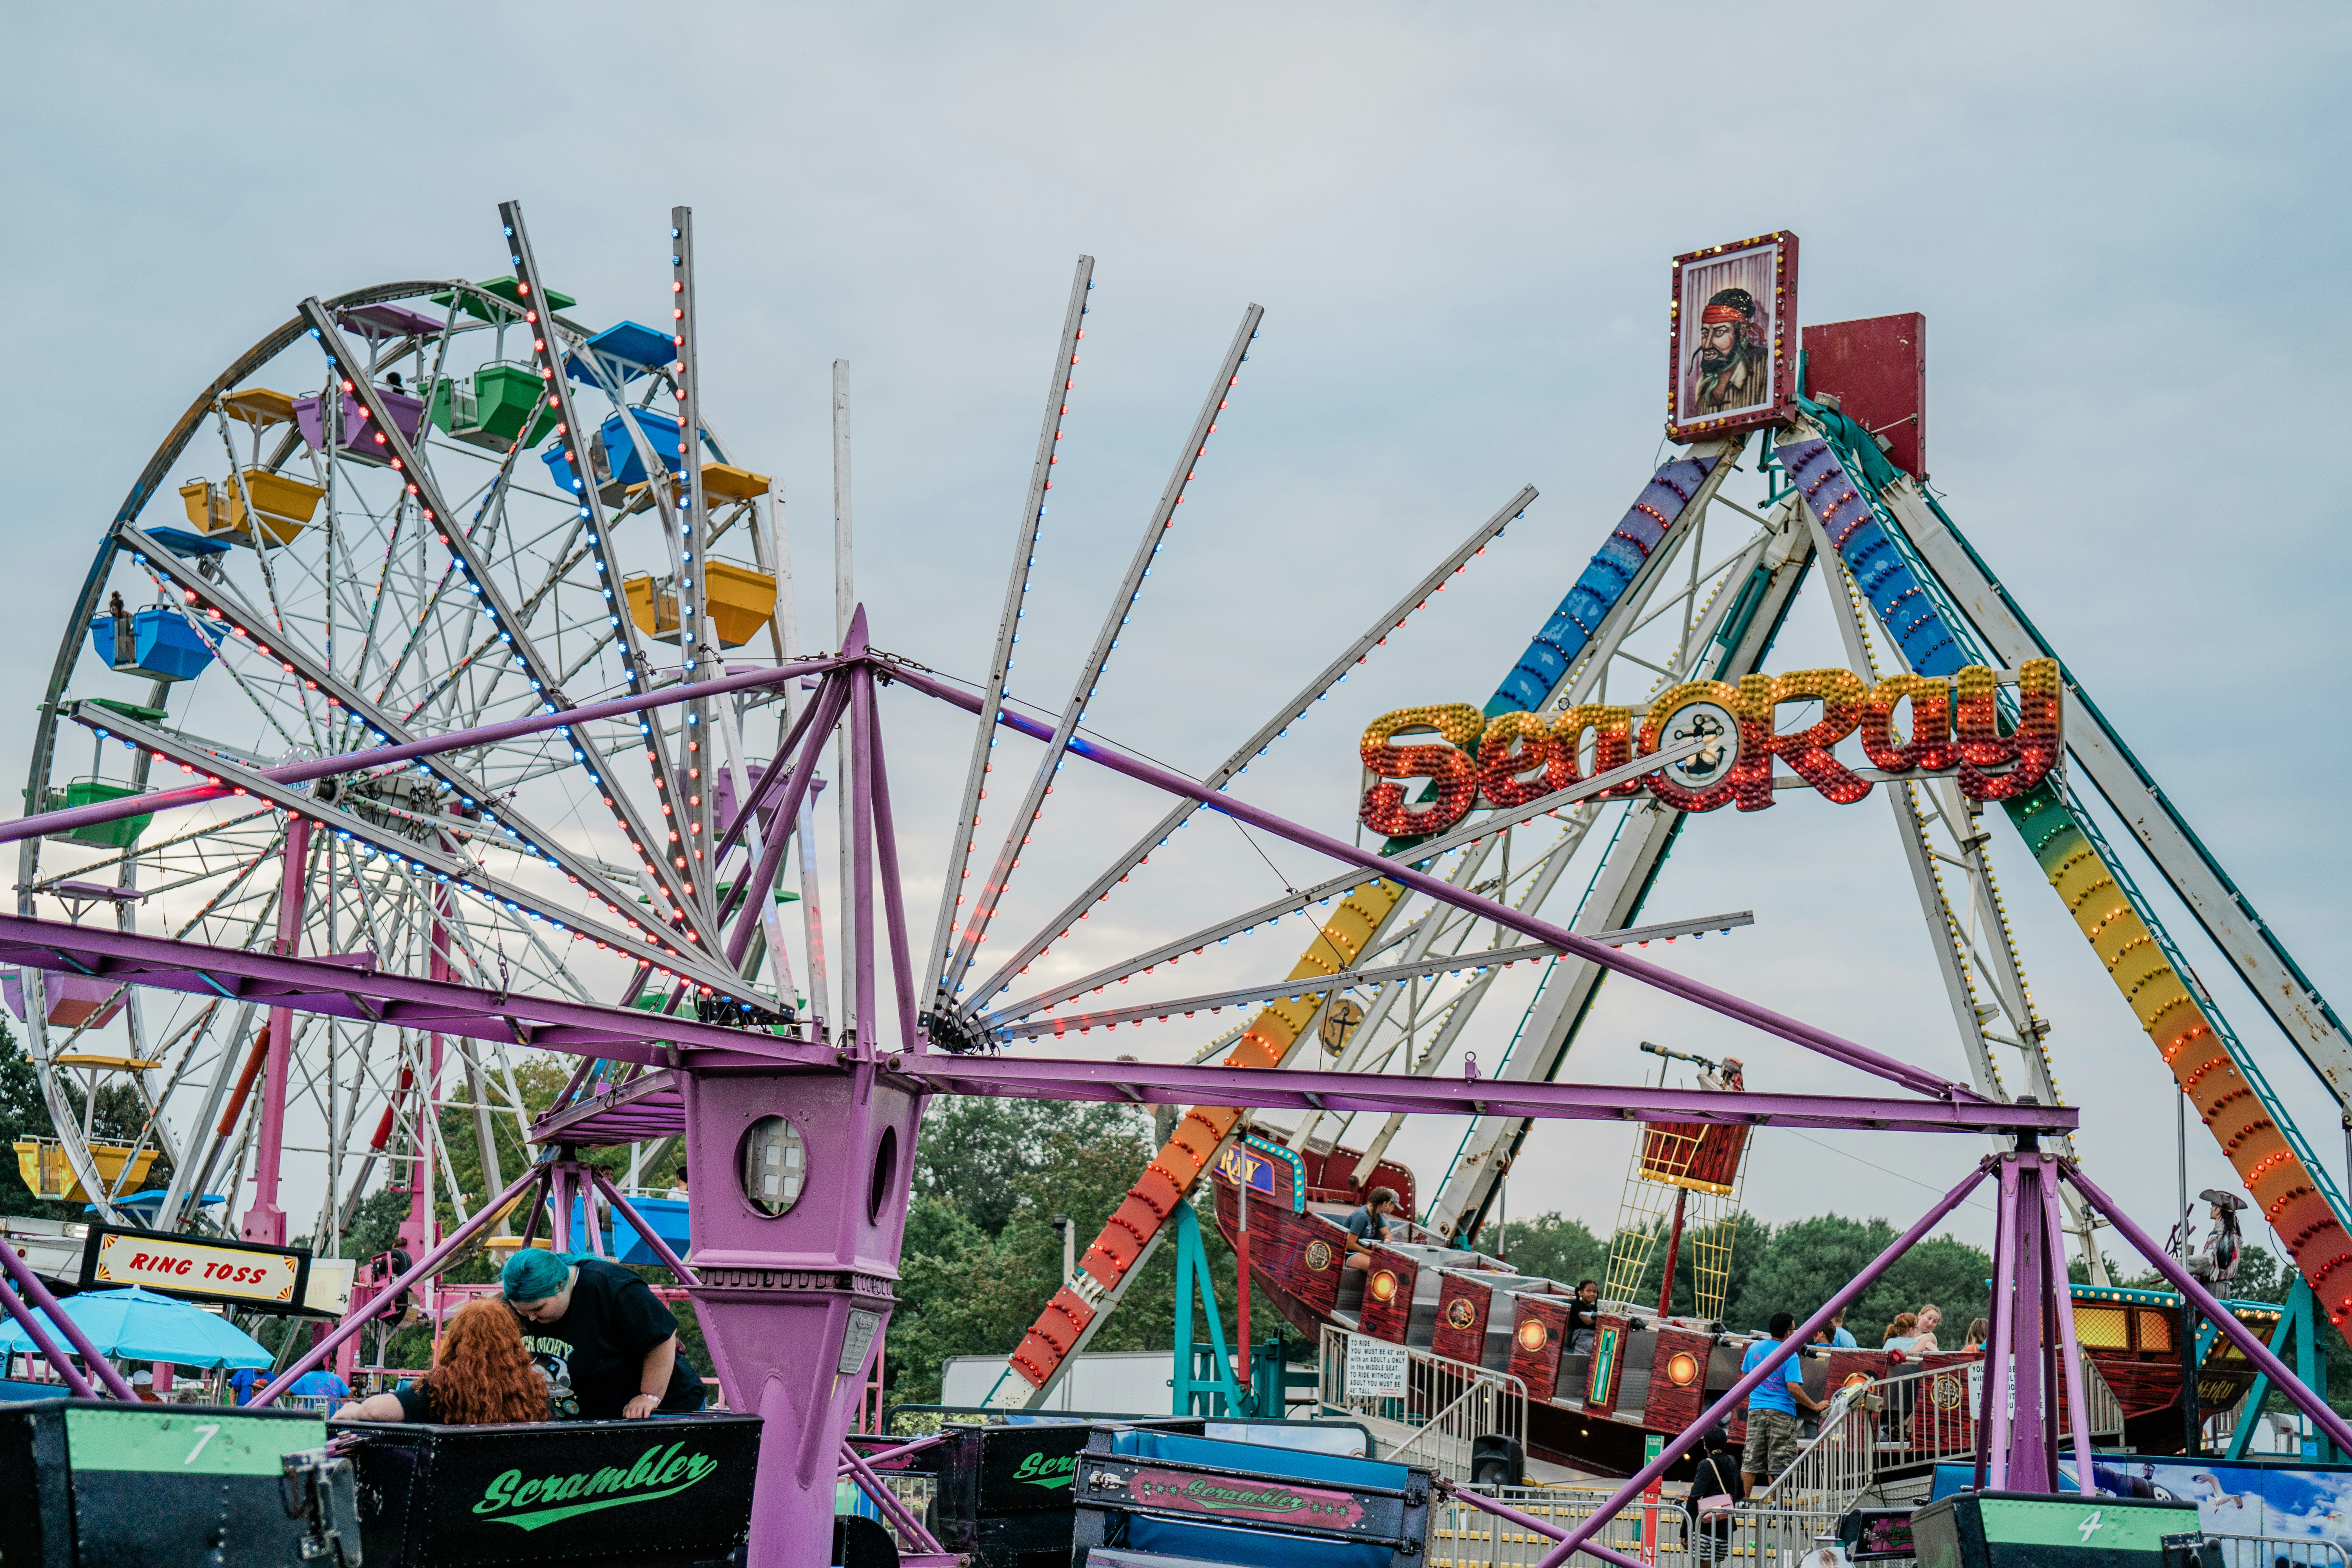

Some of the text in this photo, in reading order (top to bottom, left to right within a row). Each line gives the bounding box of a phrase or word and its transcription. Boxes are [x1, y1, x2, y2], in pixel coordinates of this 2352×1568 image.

[129, 1253, 267, 1284] RING TOSS
[185, 1424, 220, 1465] 7
[473, 1440, 718, 1516] Scrambler
[1181, 1479, 1308, 1510] Scrambler
[2077, 1511, 2103, 1542] 4
